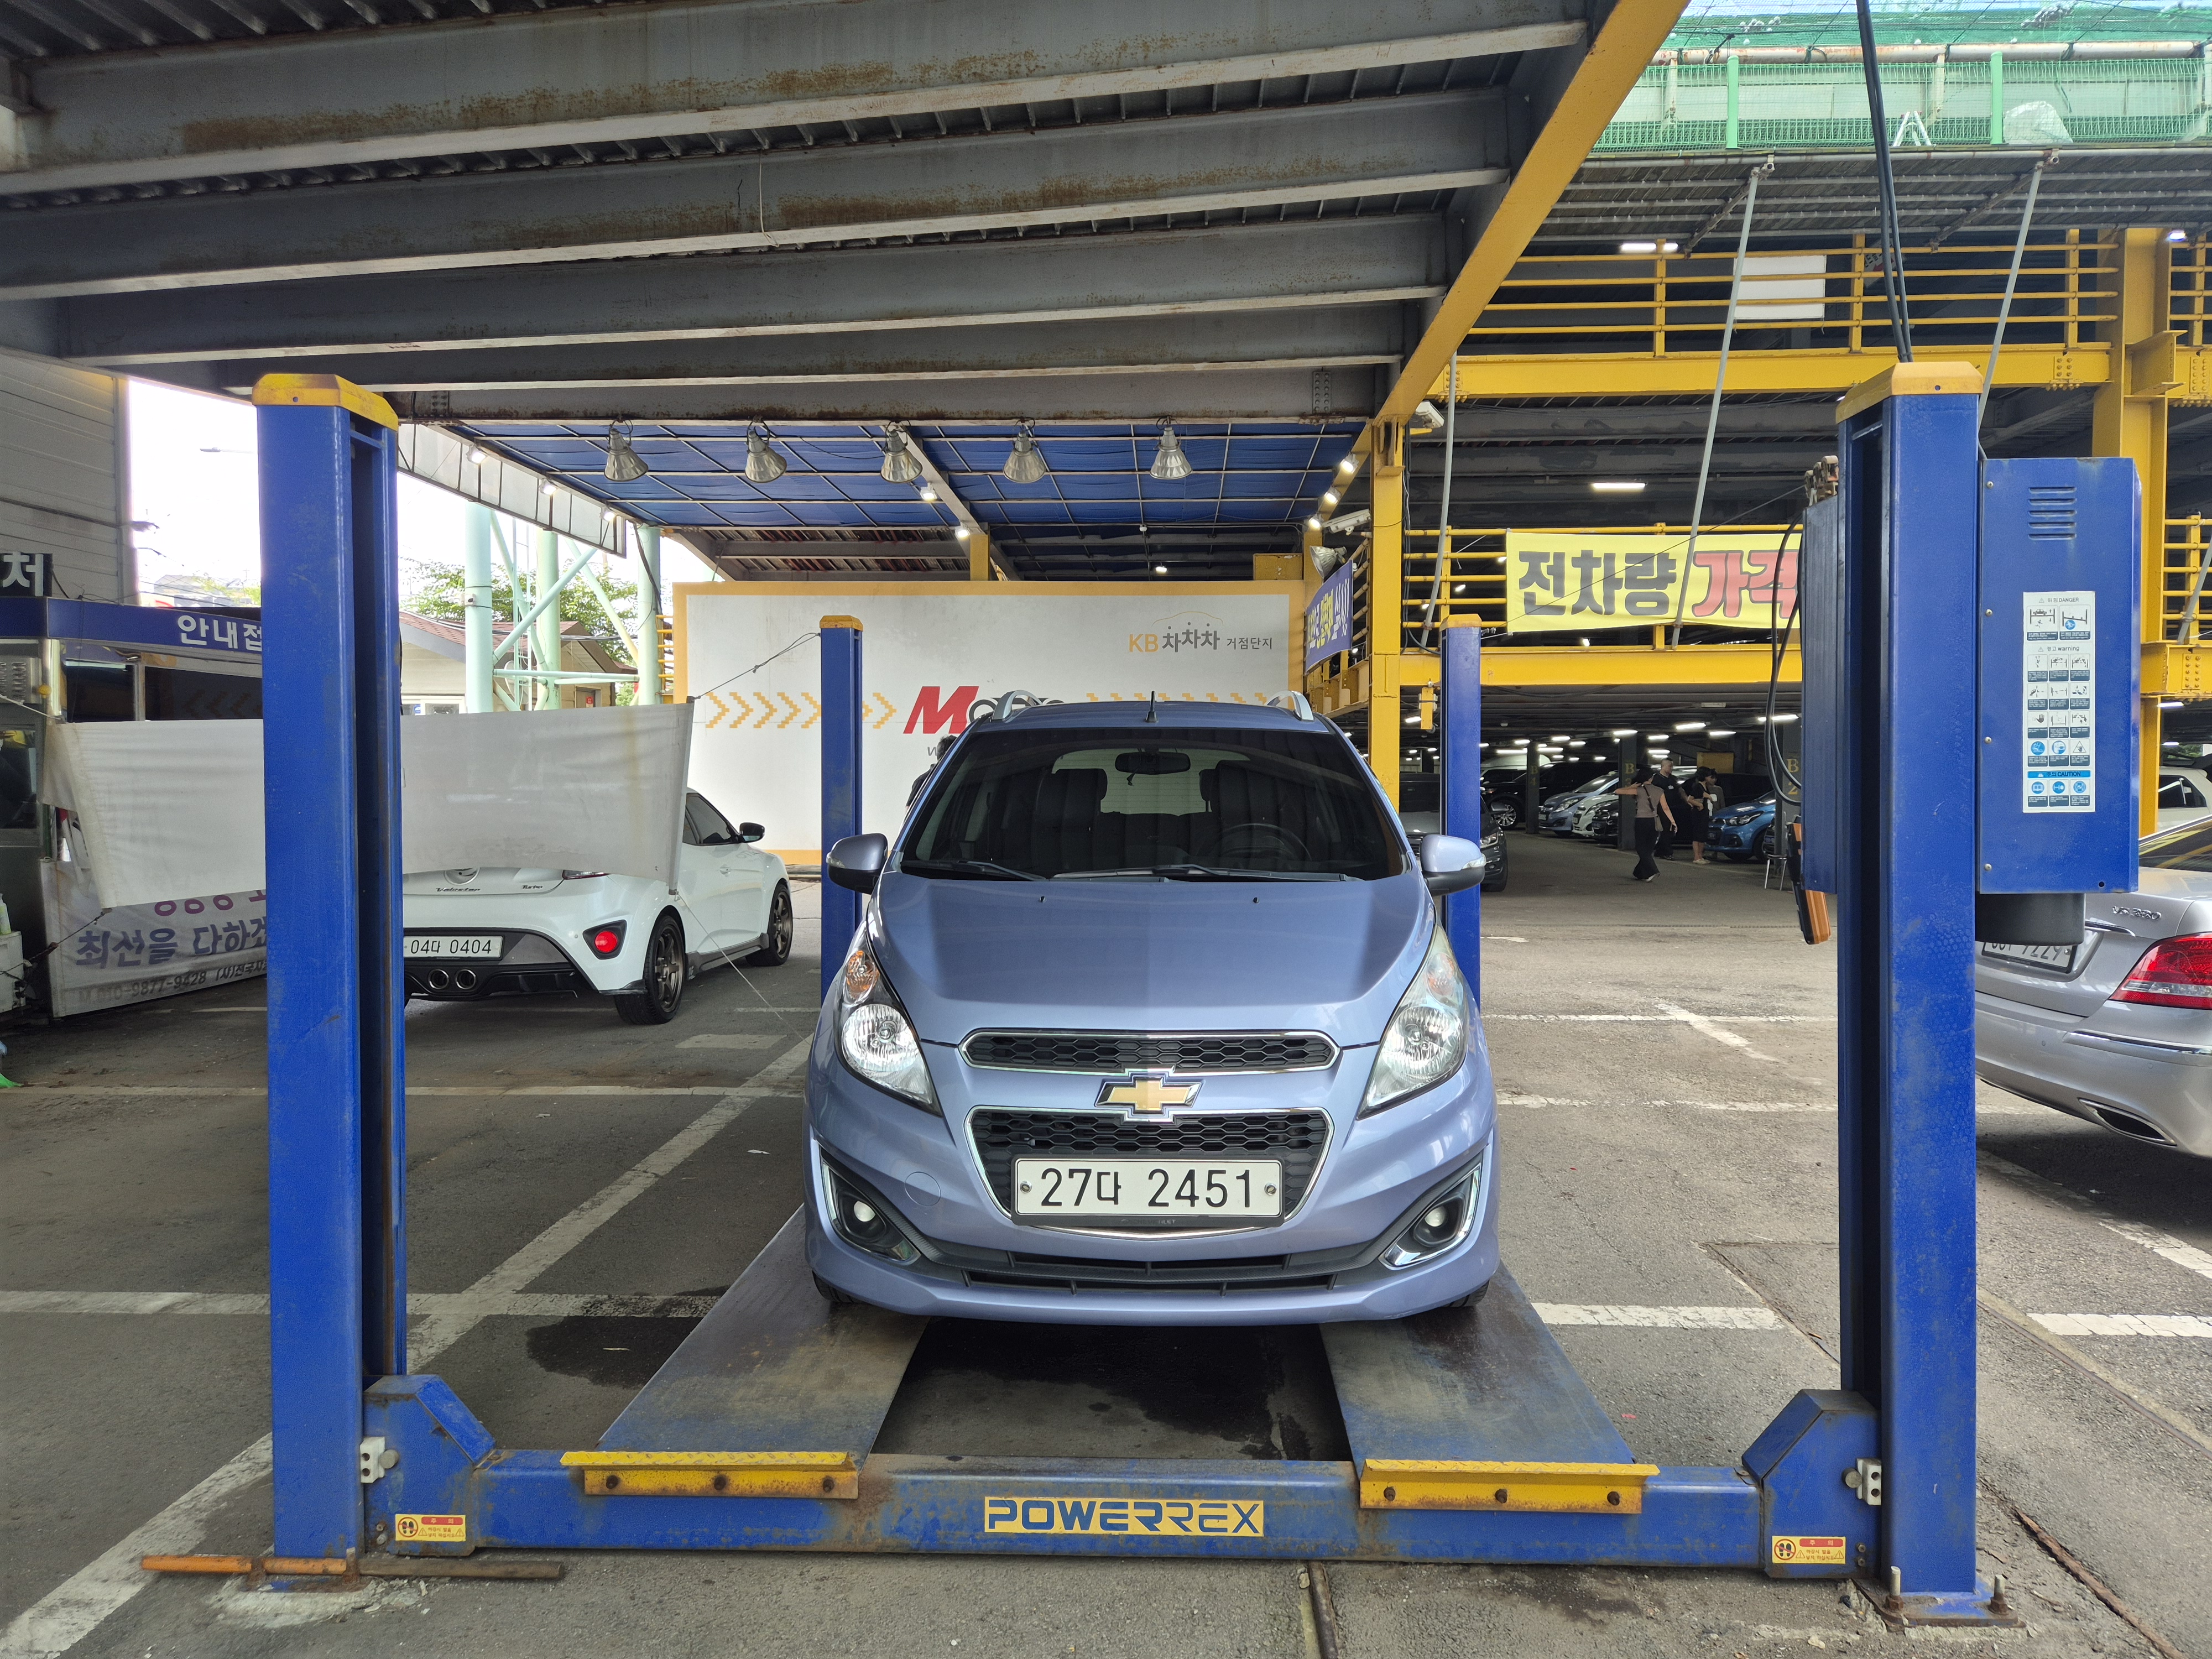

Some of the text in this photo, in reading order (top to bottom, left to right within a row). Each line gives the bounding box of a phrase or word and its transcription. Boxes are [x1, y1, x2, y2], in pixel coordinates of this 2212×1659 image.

[2, 554, 44, 597] 처
[1519, 549, 1799, 619] 전차량 가격
[178, 614, 262, 651] 안내접
[1129, 622, 1272, 653] KB 차차차 거점단지
[1531, 765, 1538, 774] B
[1625, 763, 1635, 774] B
[1787, 758, 1799, 773] B
[75, 928, 179, 969] 최선을
[411, 939, 491, 954] 04다 0404
[97, 972, 207, 1000] 0-9877-9428
[215, 959, 267, 982] (사)전국자
[1041, 1167, 1250, 1208] 27다 2451
[988, 1499, 1260, 1534] POWERREX
